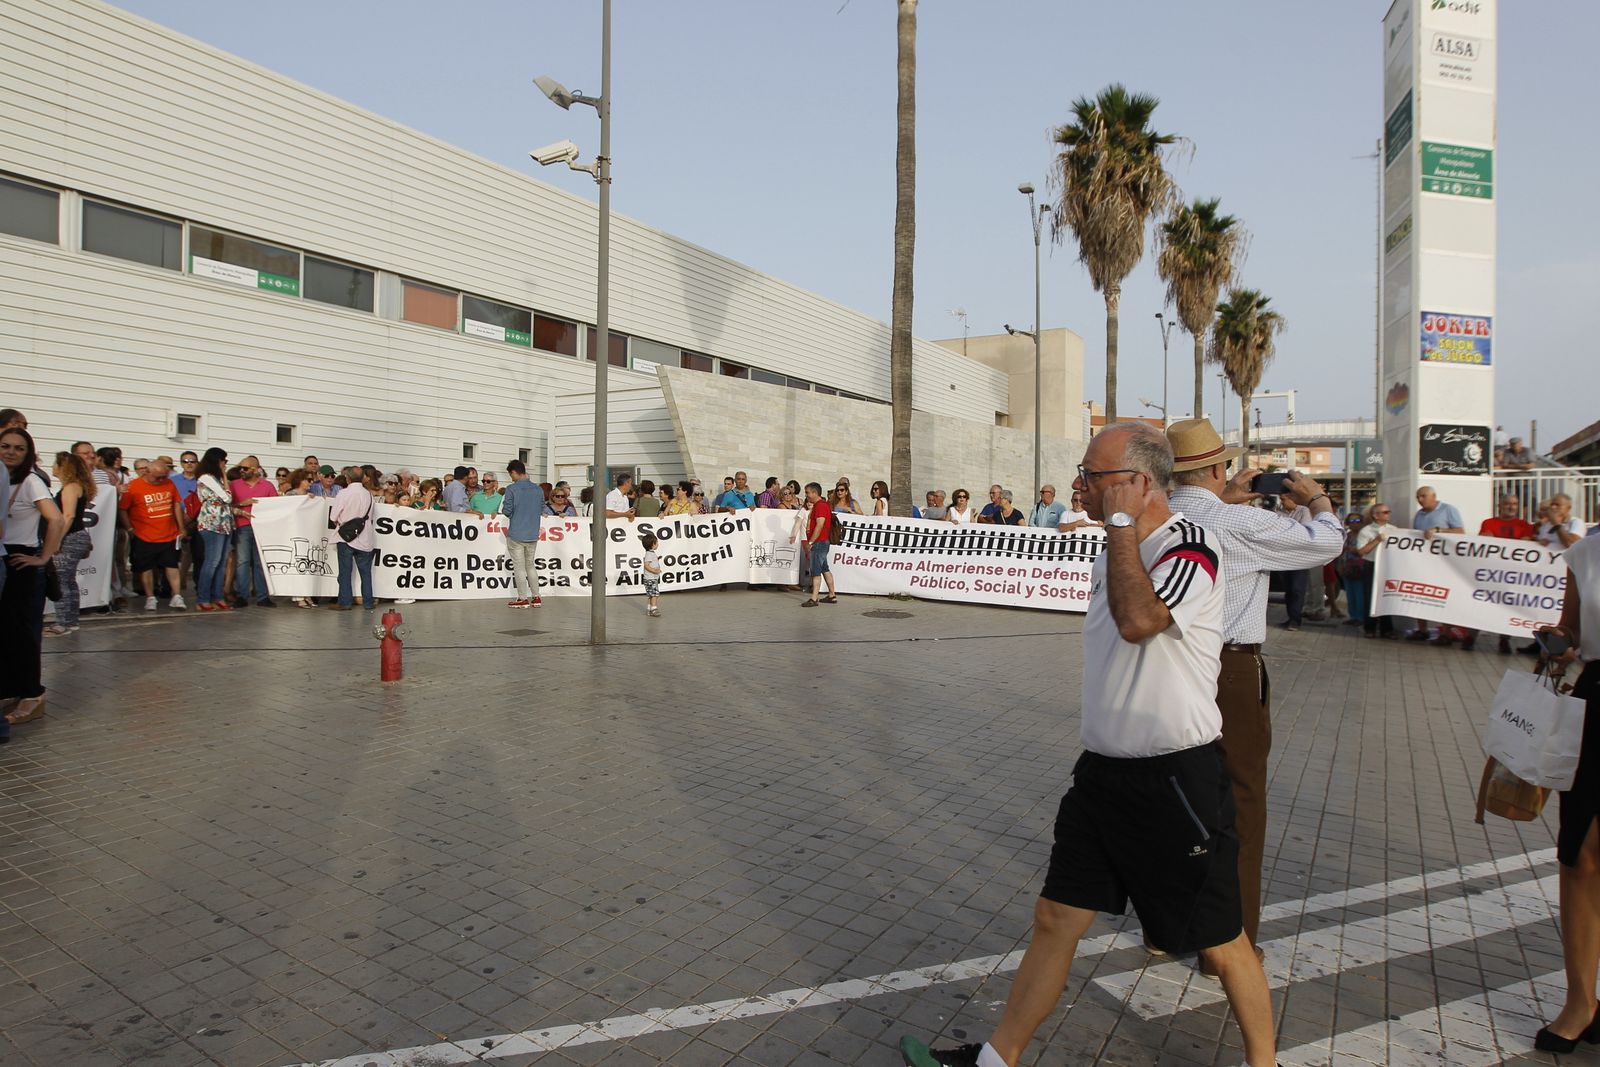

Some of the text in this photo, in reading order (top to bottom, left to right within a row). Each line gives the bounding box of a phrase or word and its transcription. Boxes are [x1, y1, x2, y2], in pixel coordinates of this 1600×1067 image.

[1435, 37, 1473, 57] ALSA
[1423, 316, 1489, 336] JOKER
[1447, 350, 1483, 363] JUEGO
[637, 517, 751, 540] Solución
[433, 556, 459, 570] en
[466, 554, 562, 571] Defesa
[614, 543, 733, 570] Feocarril
[1385, 536, 1562, 565] POR EL EMPLEO Y
[396, 570, 426, 589] de
[433, 571, 453, 589] la
[460, 570, 570, 589] Provicia
[615, 567, 705, 586] Alería
[833, 552, 1090, 583] Plataforma Almeriense en Defens
[910, 575, 969, 594] Público,
[974, 579, 1022, 596] Social
[1025, 585, 1036, 599] y
[1401, 582, 1447, 598] CCOO
[1475, 568, 1567, 591] EXIGIMOS
[1472, 589, 1565, 611] EXIGIMOS
